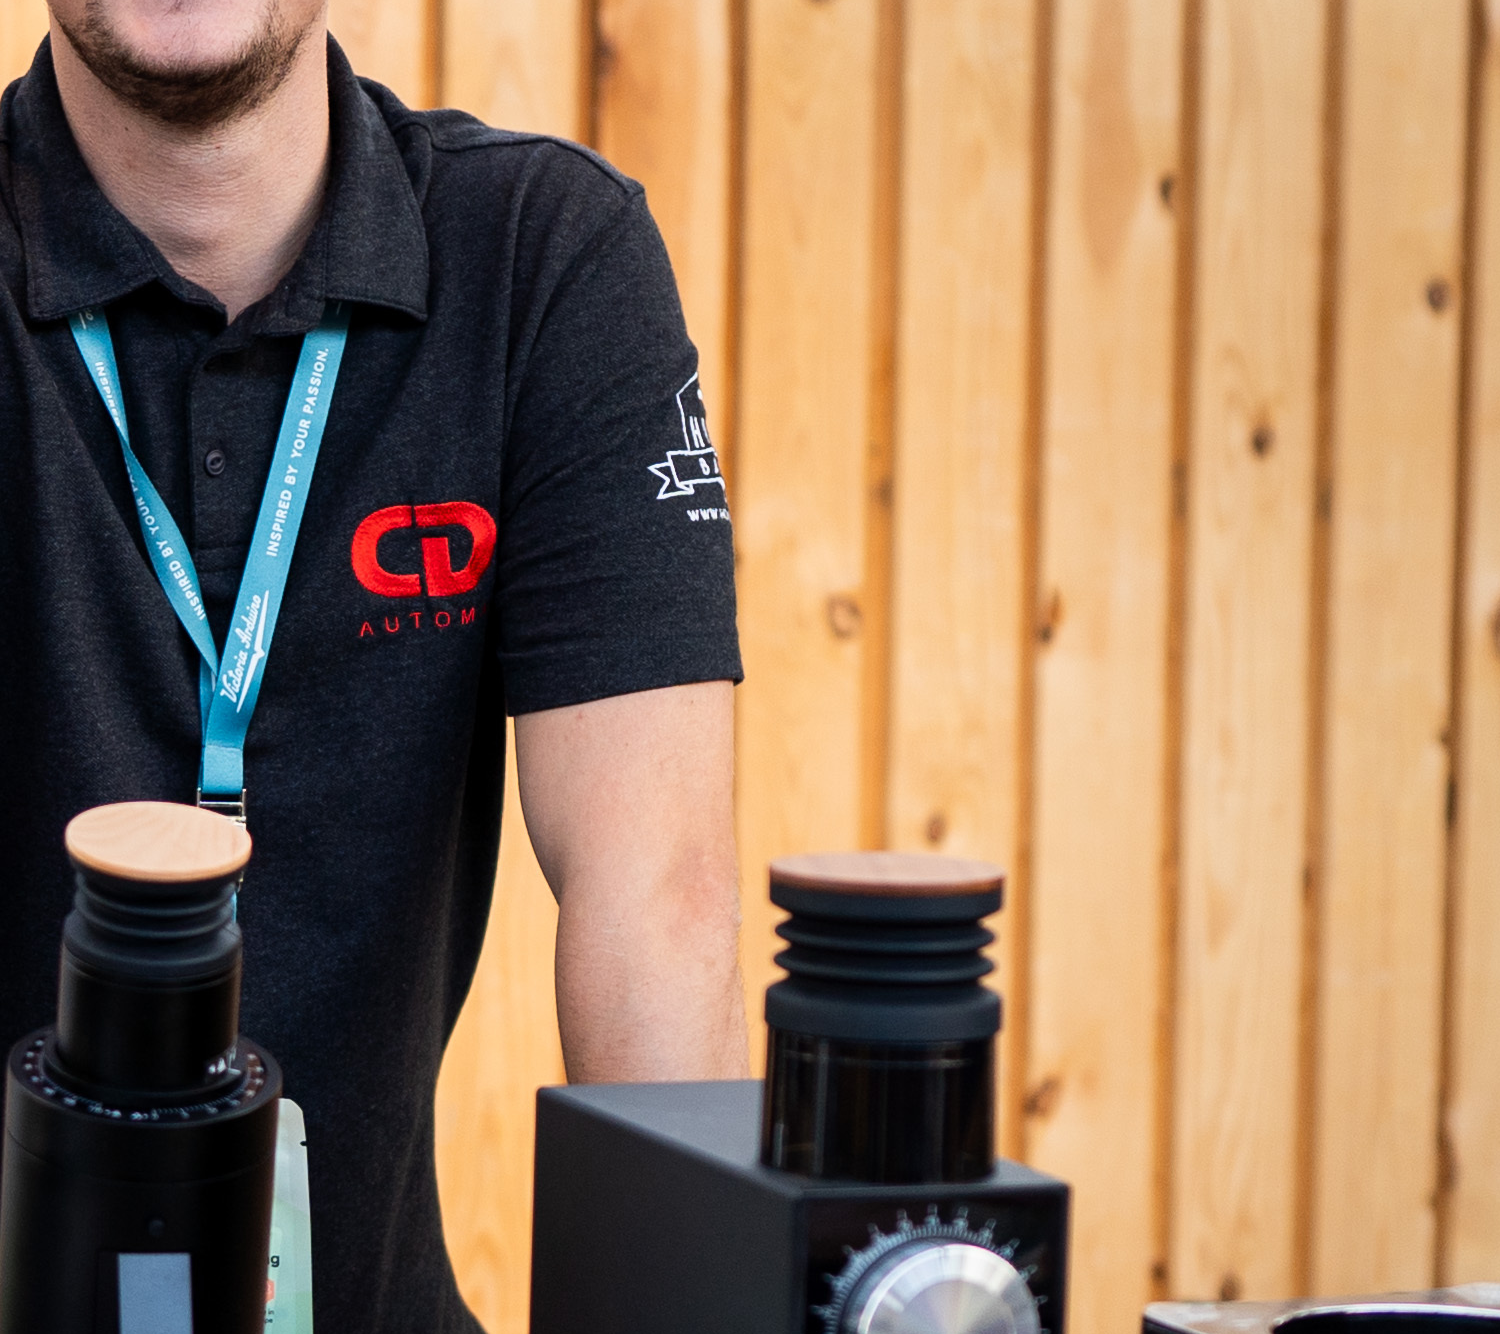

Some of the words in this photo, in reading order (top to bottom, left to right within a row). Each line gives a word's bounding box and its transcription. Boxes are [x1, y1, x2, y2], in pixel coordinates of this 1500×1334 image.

[302, 347, 330, 416] PASSION.
[290, 418, 312, 460] YOUR
[283, 464, 299, 487] BY
[137, 496, 157, 536] YOUR
[266, 489, 293, 558] INSPIRED
[155, 538, 174, 559] BY
[351, 501, 498, 598] CD
[168, 560, 207, 621] INSPIRED
[359, 605, 486, 638] AUTOM
[219, 648, 248, 704] Victoria
[234, 594, 262, 649] Arduino
